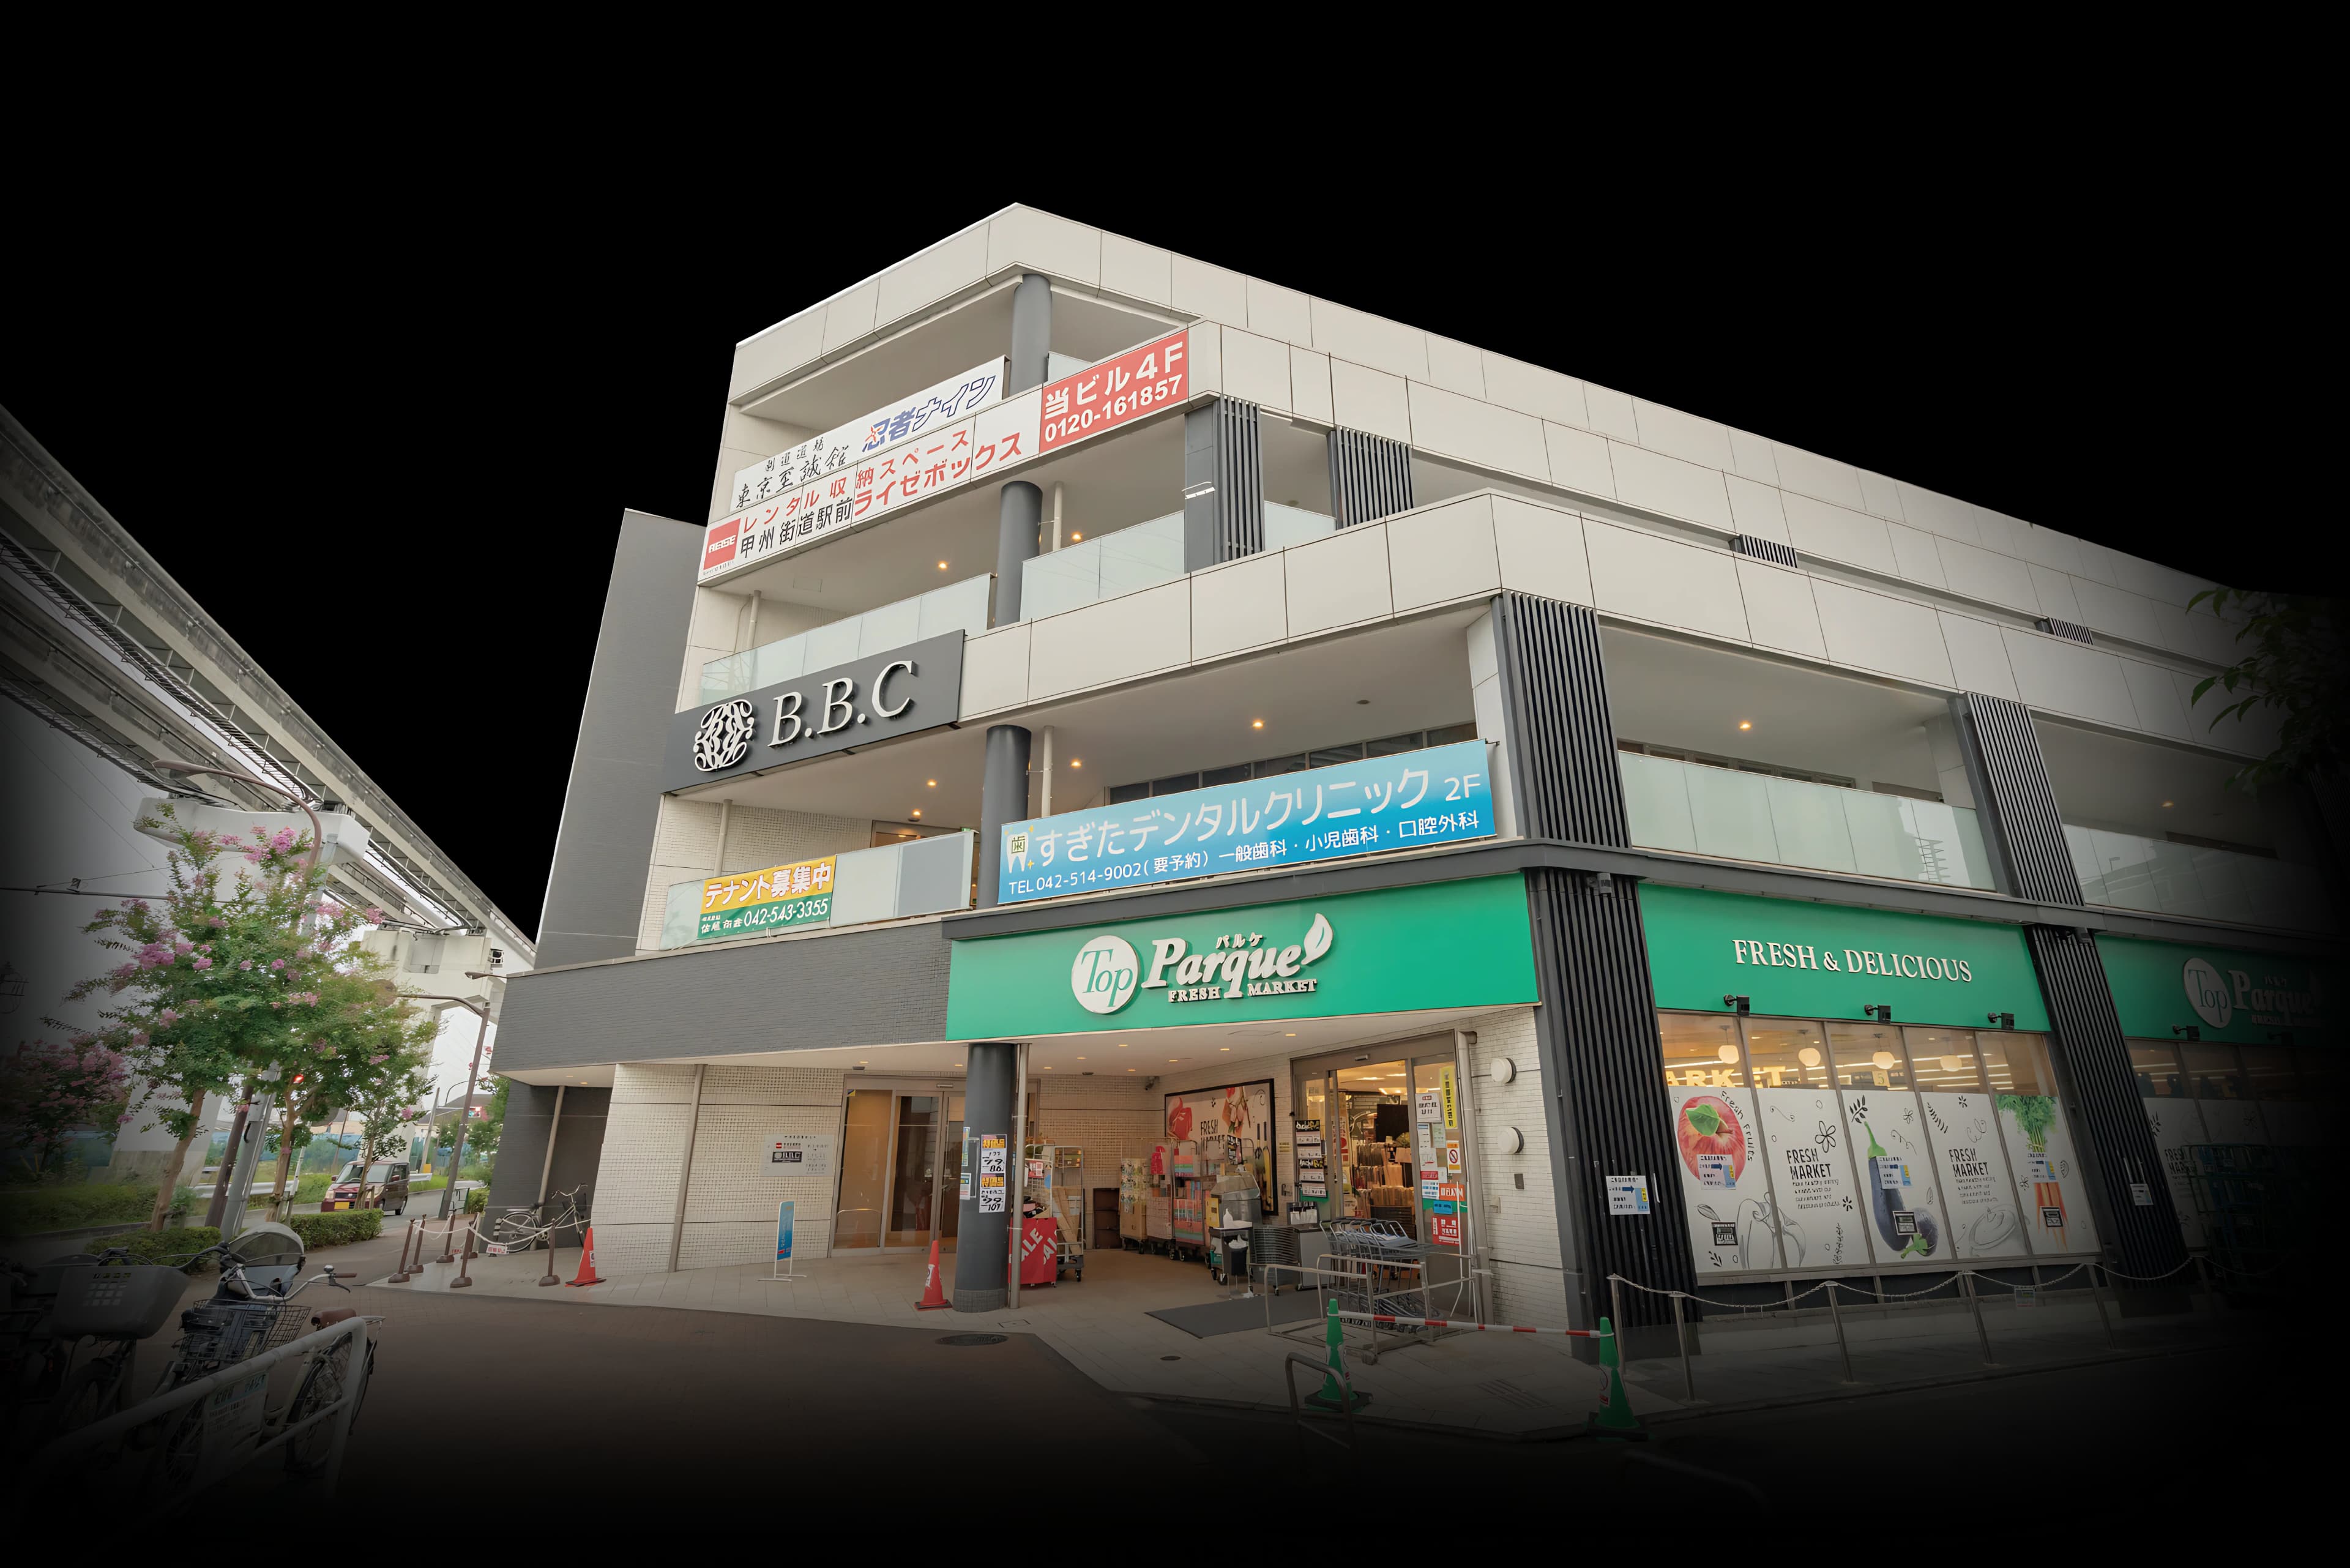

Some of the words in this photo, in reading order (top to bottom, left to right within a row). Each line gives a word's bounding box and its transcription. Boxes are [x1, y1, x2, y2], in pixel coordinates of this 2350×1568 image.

[1045, 341, 1183, 420] 当ビル4F
[862, 375, 996, 452] 忍者ナイン
[1045, 374, 1182, 442] 0120-161857
[744, 430, 969, 533] レンタル収納スペース
[854, 432, 1022, 516] ライゼボックス
[767, 660, 917, 748] B.B.C
[1035, 768, 1429, 867] すぎたデンタルクリニック
[1444, 773, 1481, 802] 2F
[1011, 835, 1026, 854] 歯
[706, 862, 831, 908] テナント募集中
[1009, 879, 1034, 895] TEL
[1036, 862, 1142, 892] 042-514-9002
[744, 898, 828, 928] 042-543-3355
[1216, 932, 1263, 949] パルケ
[1733, 939, 1819, 970] FRESH
[1823, 951, 1841, 972] &
[1843, 949, 1972, 982] DELICIOUS
[1081, 949, 1133, 1007] Top
[1141, 937, 1302, 998] Parque
[1168, 986, 1220, 1002] FRESH
[1247, 979, 1317, 996] MARKET
[2188, 969, 2227, 1023] Top
[1721, 1091, 1744, 1120] Fresh
[1786, 1148, 1819, 1164] FRESH
[1789, 1163, 1831, 1180] MARKET
[1949, 1148, 1977, 1162] FRESH
[1952, 1162, 1988, 1178] MARKET
